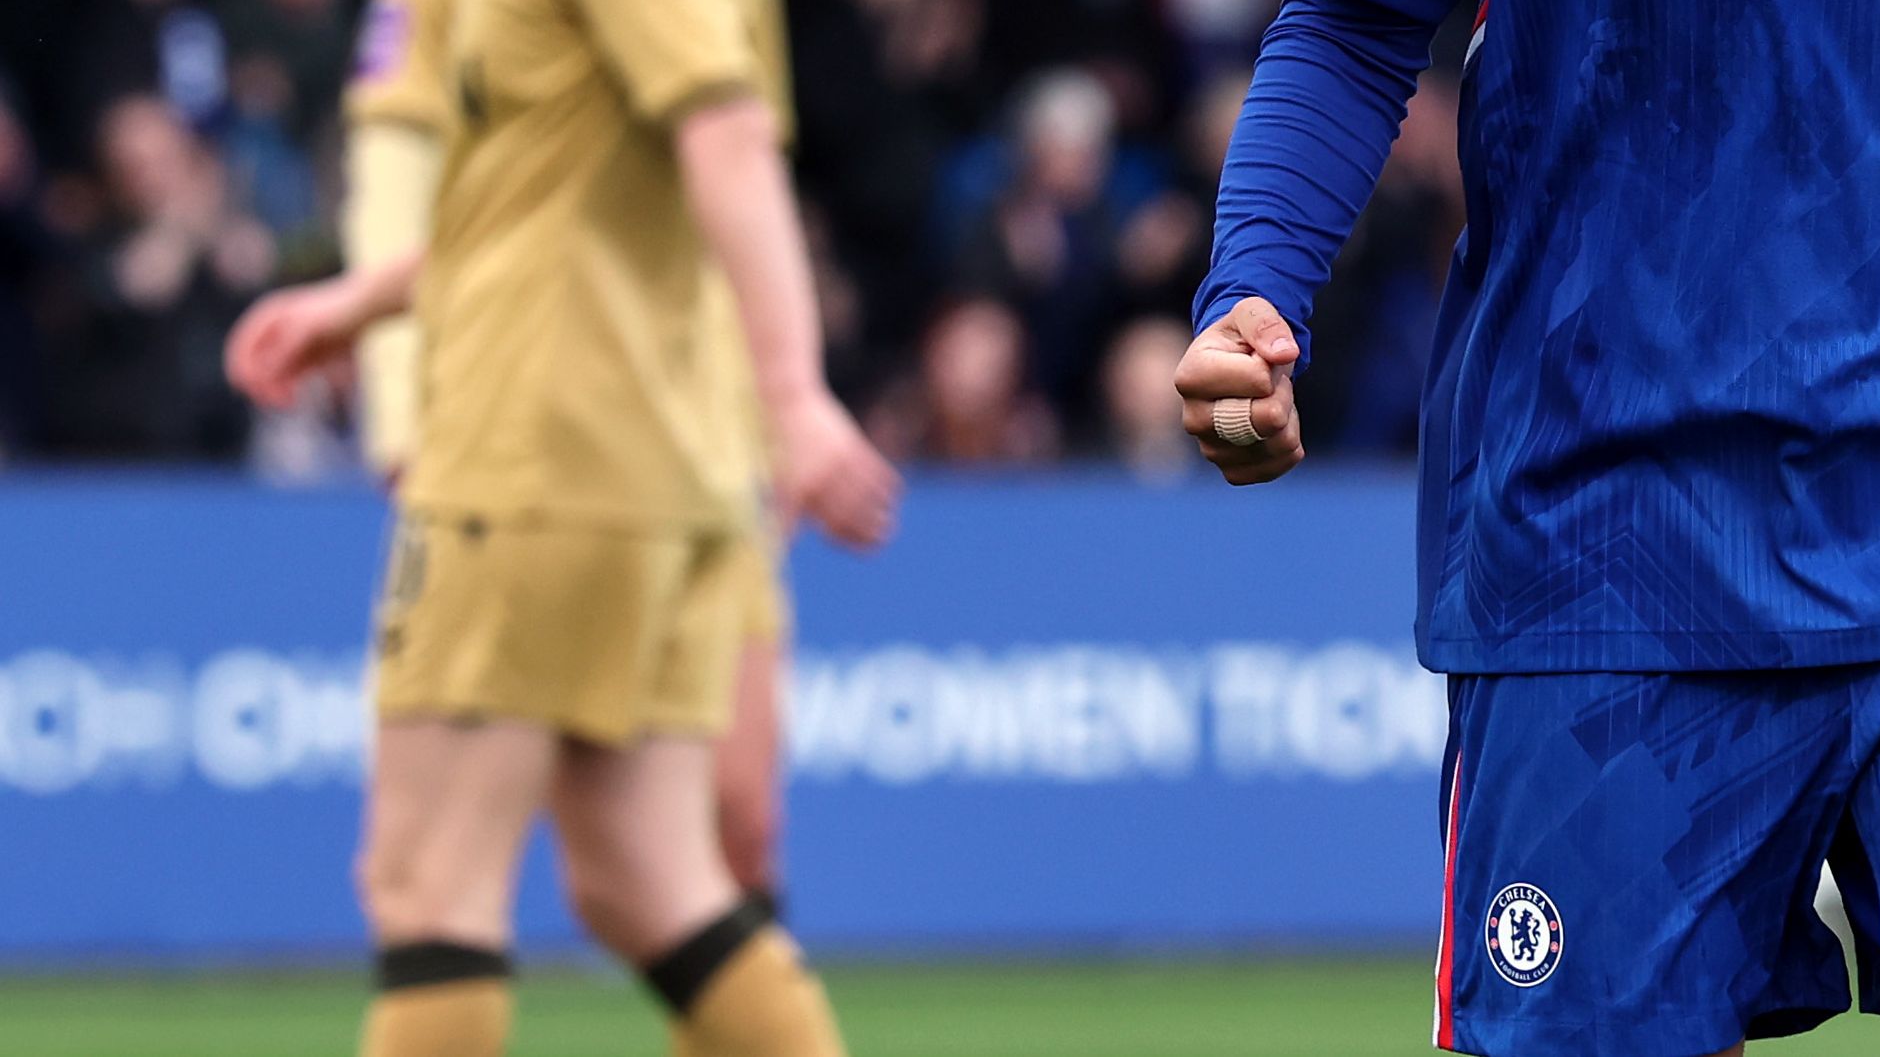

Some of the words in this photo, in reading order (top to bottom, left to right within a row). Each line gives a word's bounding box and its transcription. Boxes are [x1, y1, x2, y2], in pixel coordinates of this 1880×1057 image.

[1499, 888, 1545, 910] CHELSEA
[1500, 961, 1529, 979] FOOTBALL
[1533, 962, 1550, 978] CLUB
